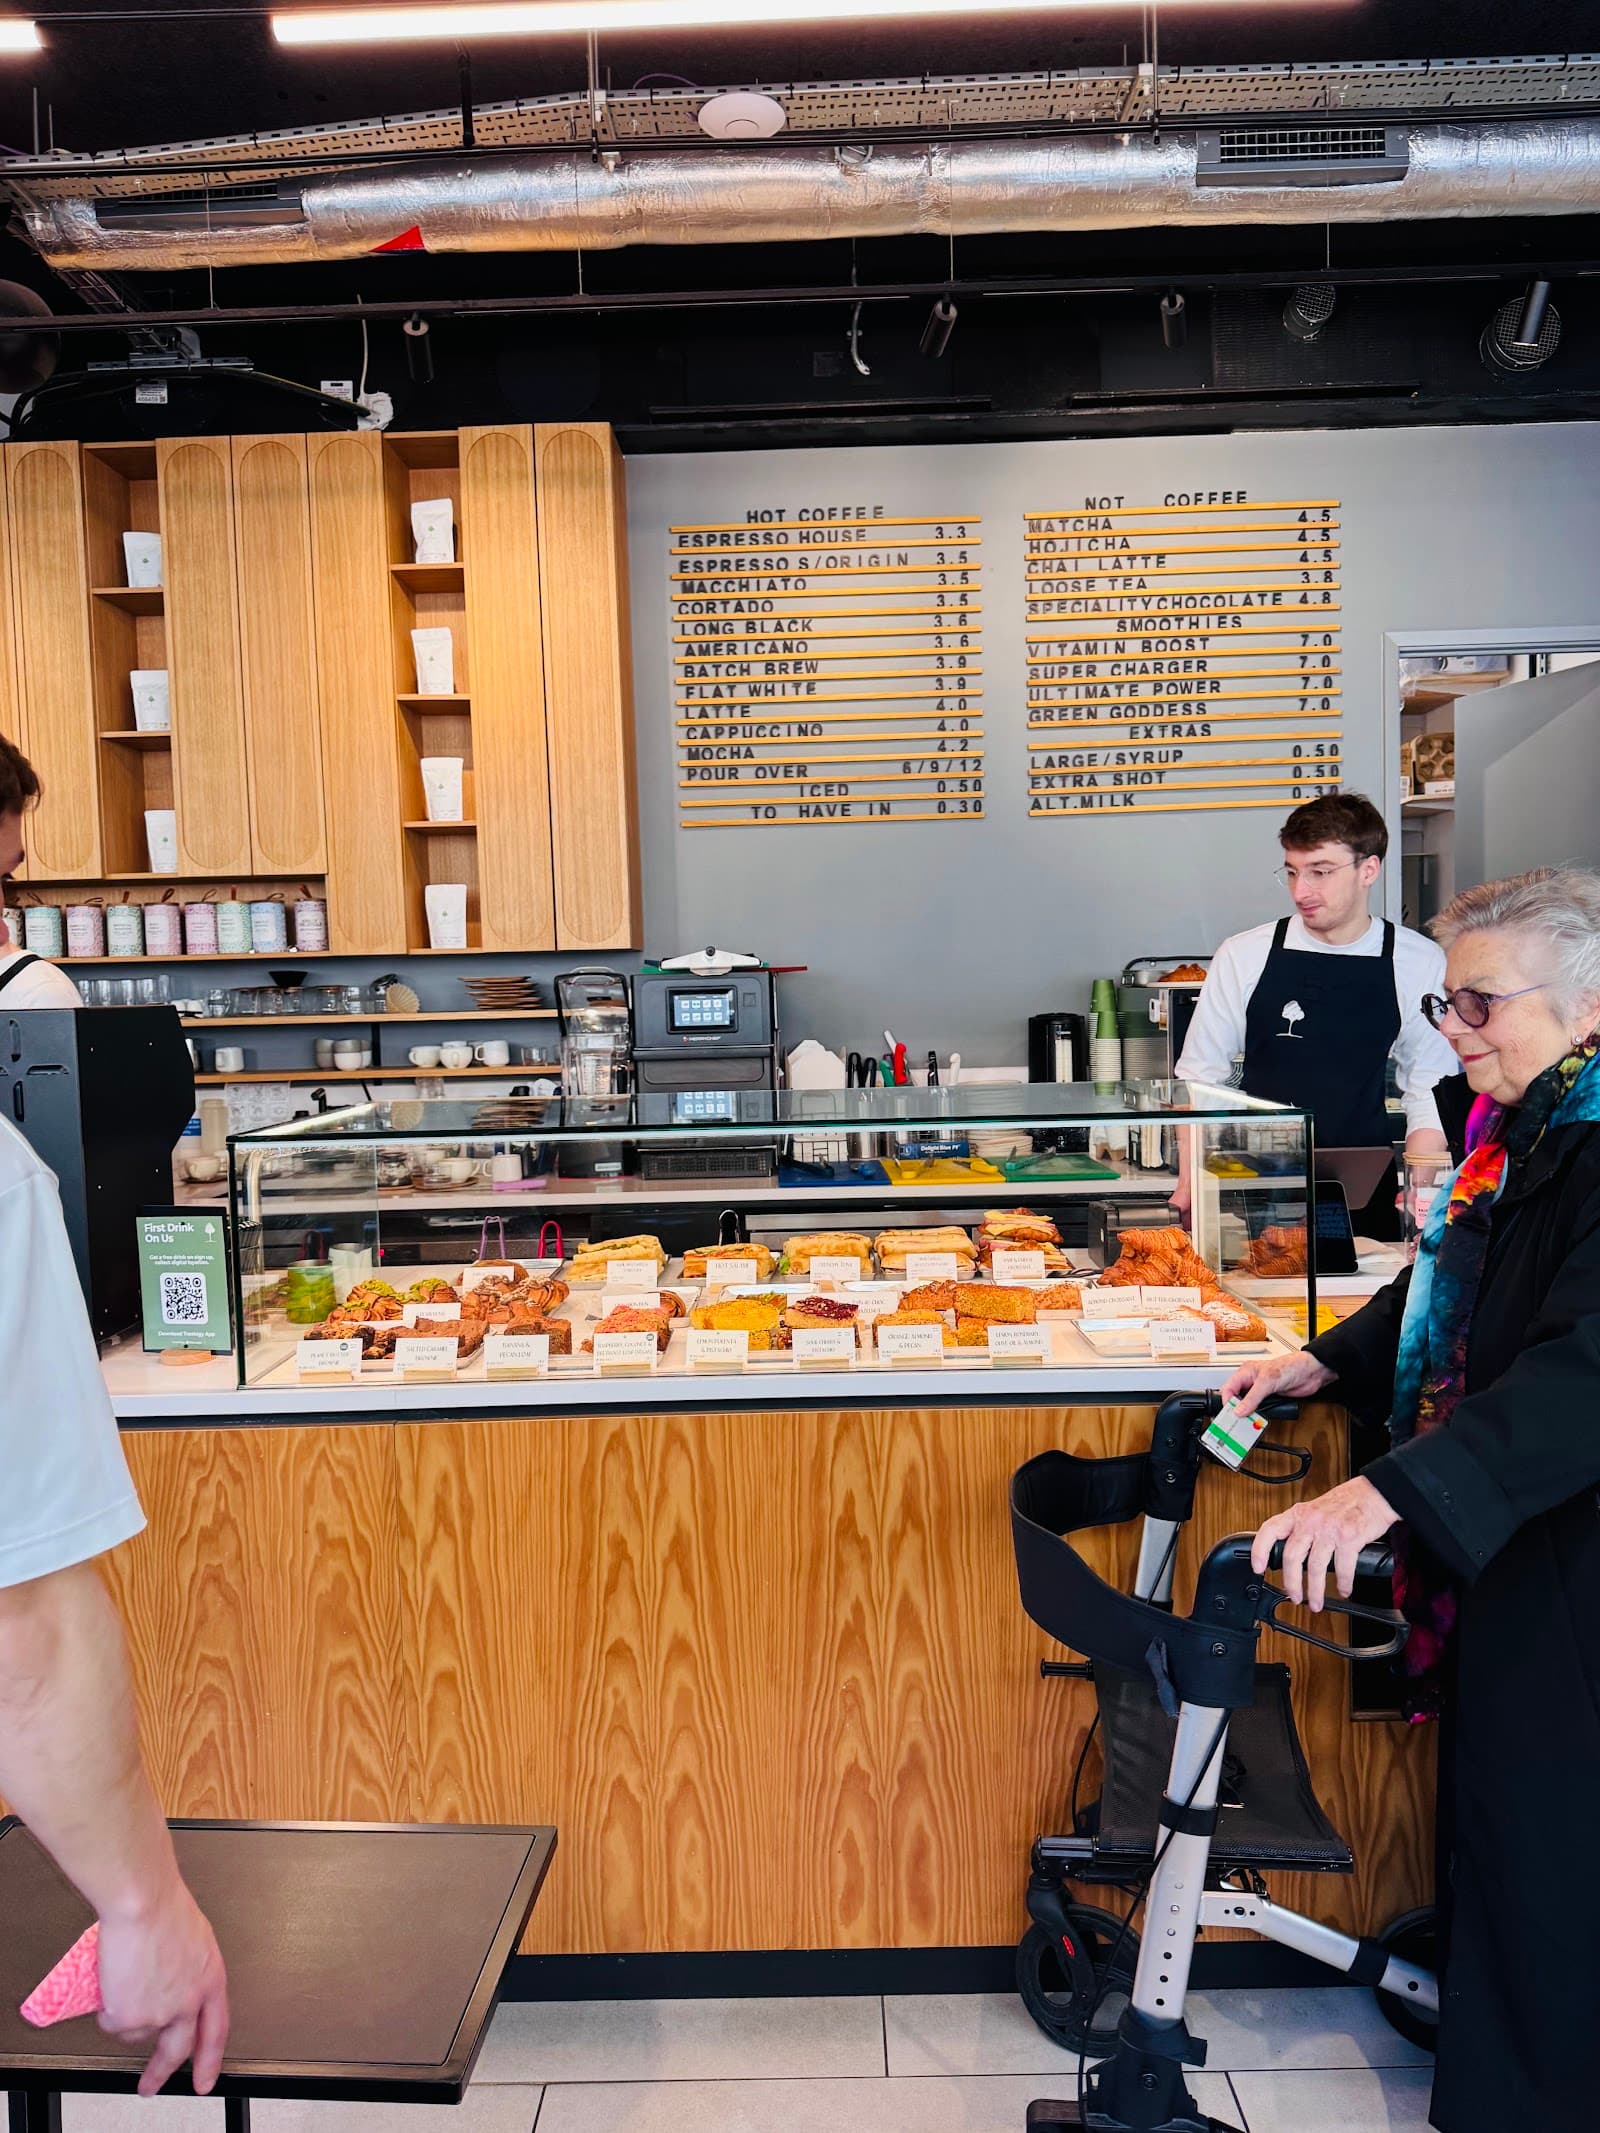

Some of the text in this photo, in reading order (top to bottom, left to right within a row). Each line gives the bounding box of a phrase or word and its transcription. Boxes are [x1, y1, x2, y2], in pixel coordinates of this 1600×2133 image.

[1085, 491, 1248, 510] NOT COFFEE
[747, 505, 885, 523] HOT COFFEE
[1028, 510, 1331, 534] MATCHA 4.5
[679, 526, 966, 548] ESPRESSO HOUSE 3.3
[1029, 529, 1330, 554] HOJICHA 4.5
[679, 552, 967, 573] ESPRESSO S/ORIGIN 3.5
[1028, 550, 1333, 574] CHAI LATTE 4.5
[681, 572, 969, 594] MACCHIATO 3.5
[1029, 571, 1333, 595] LOOSE TEA 3.8
[678, 593, 967, 615] CORTADO 3.5
[1300, 592, 1332, 605] 4.8
[681, 614, 967, 636] LONG BLACK 3.6
[1117, 615, 1242, 632] SMOOTHIES
[685, 635, 969, 657] AMERICANO 3.6
[1028, 634, 1332, 658] VITAMIN BOOST 7.0
[684, 656, 967, 678] BATCH BREW 3.9
[1029, 655, 1331, 680] SUPER CHARGER 7.0
[686, 677, 966, 699] FLAT WHITE 3.9
[1029, 676, 1333, 702] ULTIMATE POWER 7.0
[685, 698, 967, 719] LATTE 4.0
[1029, 698, 1330, 723] GREEN GODDESS 7.0
[686, 719, 969, 740] CAPPUCCINO 4.0
[1129, 724, 1212, 739] EXTRAS
[688, 739, 969, 761] MOCHA 4.2
[1031, 744, 1339, 770] LARGE/SYRUP 0.50
[688, 760, 982, 781] POUR OVER 6/9/12
[1031, 765, 1340, 789] EXTRA SHOT 0.50
[800, 780, 982, 797] ICED 0.50
[752, 800, 982, 819] TO HAVE IN 0.30
[1031, 794, 1135, 811] ALT.MILK
[144, 1223, 194, 1233] First Drink
[144, 1234, 174, 1243] On Us
